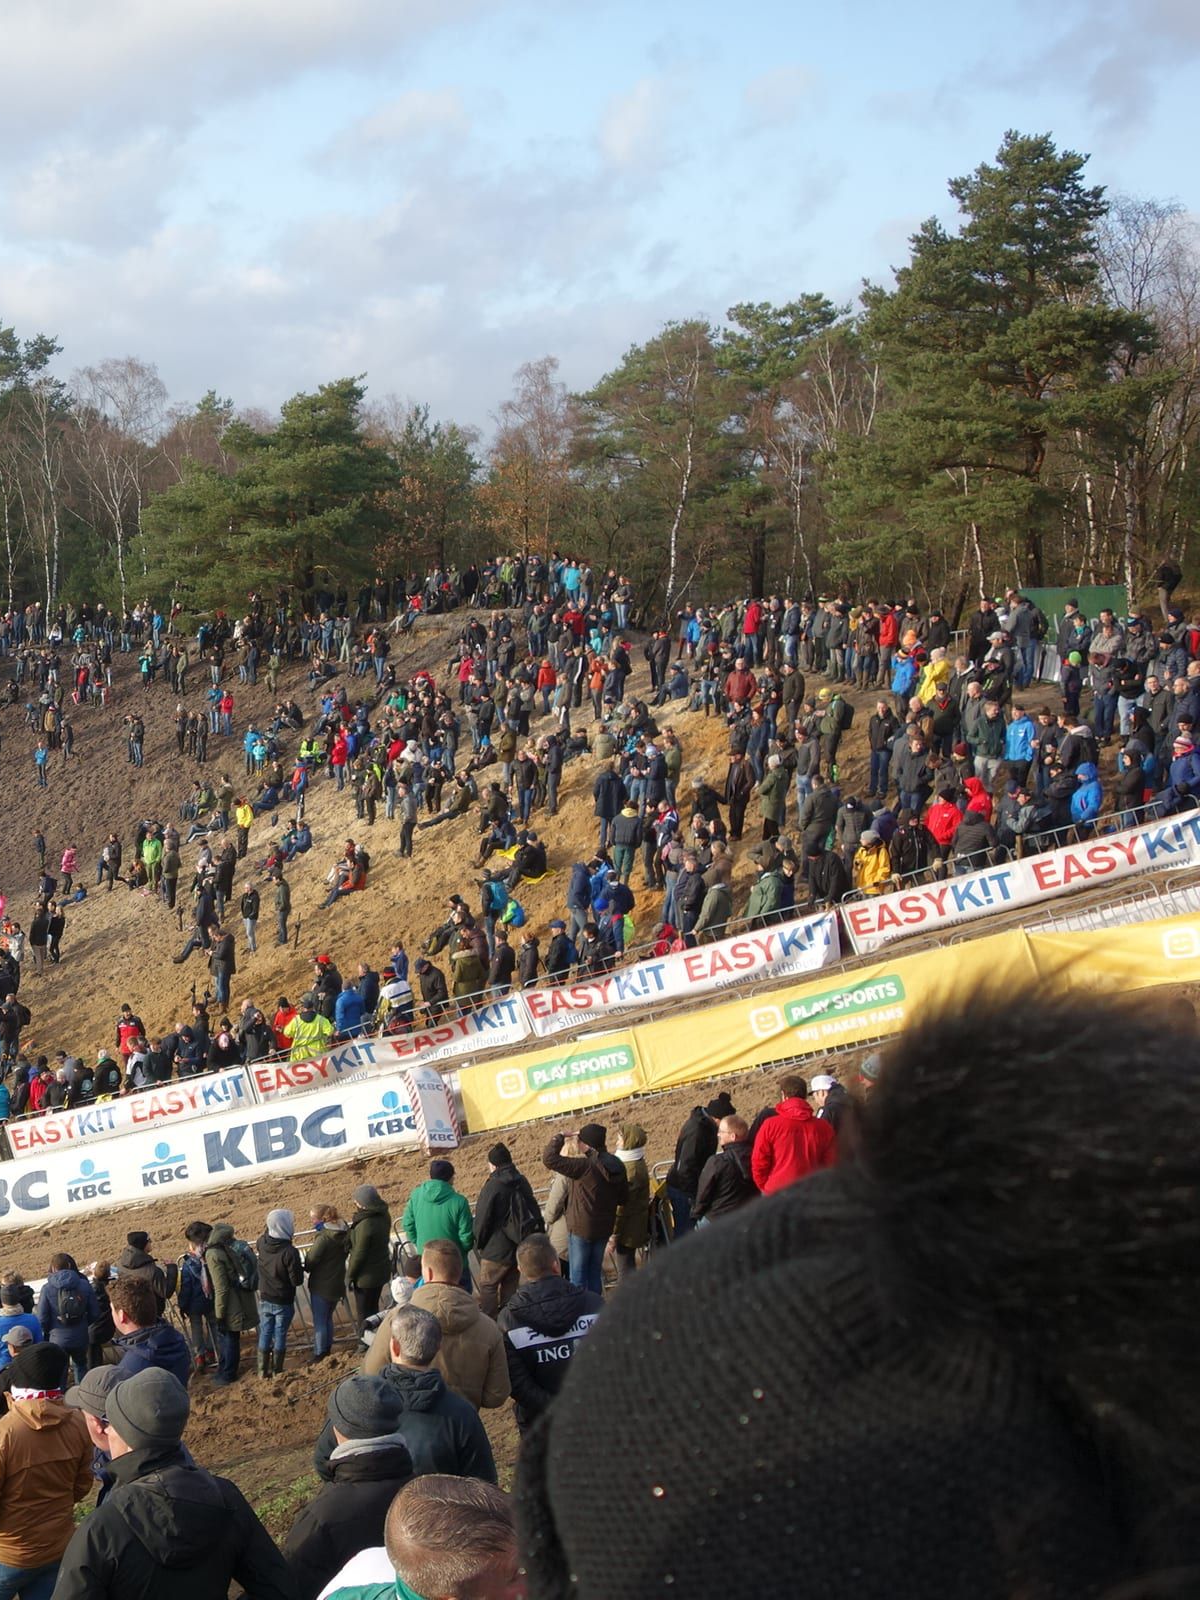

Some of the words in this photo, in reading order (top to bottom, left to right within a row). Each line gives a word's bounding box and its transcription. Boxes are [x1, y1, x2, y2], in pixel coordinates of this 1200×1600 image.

[790, 1002, 829, 1021] PLAY
[832, 981, 898, 1010] SPORTS
[532, 1065, 568, 1086] PLAY
[570, 1051, 629, 1075] SPORTS
[368, 1115, 417, 1138] KBC
[430, 1133, 454, 1141] KBC
[203, 1104, 347, 1174] KBC
[142, 1165, 189, 1187] KBC
[67, 1181, 111, 1203] KBC
[536, 1345, 570, 1363] ING
